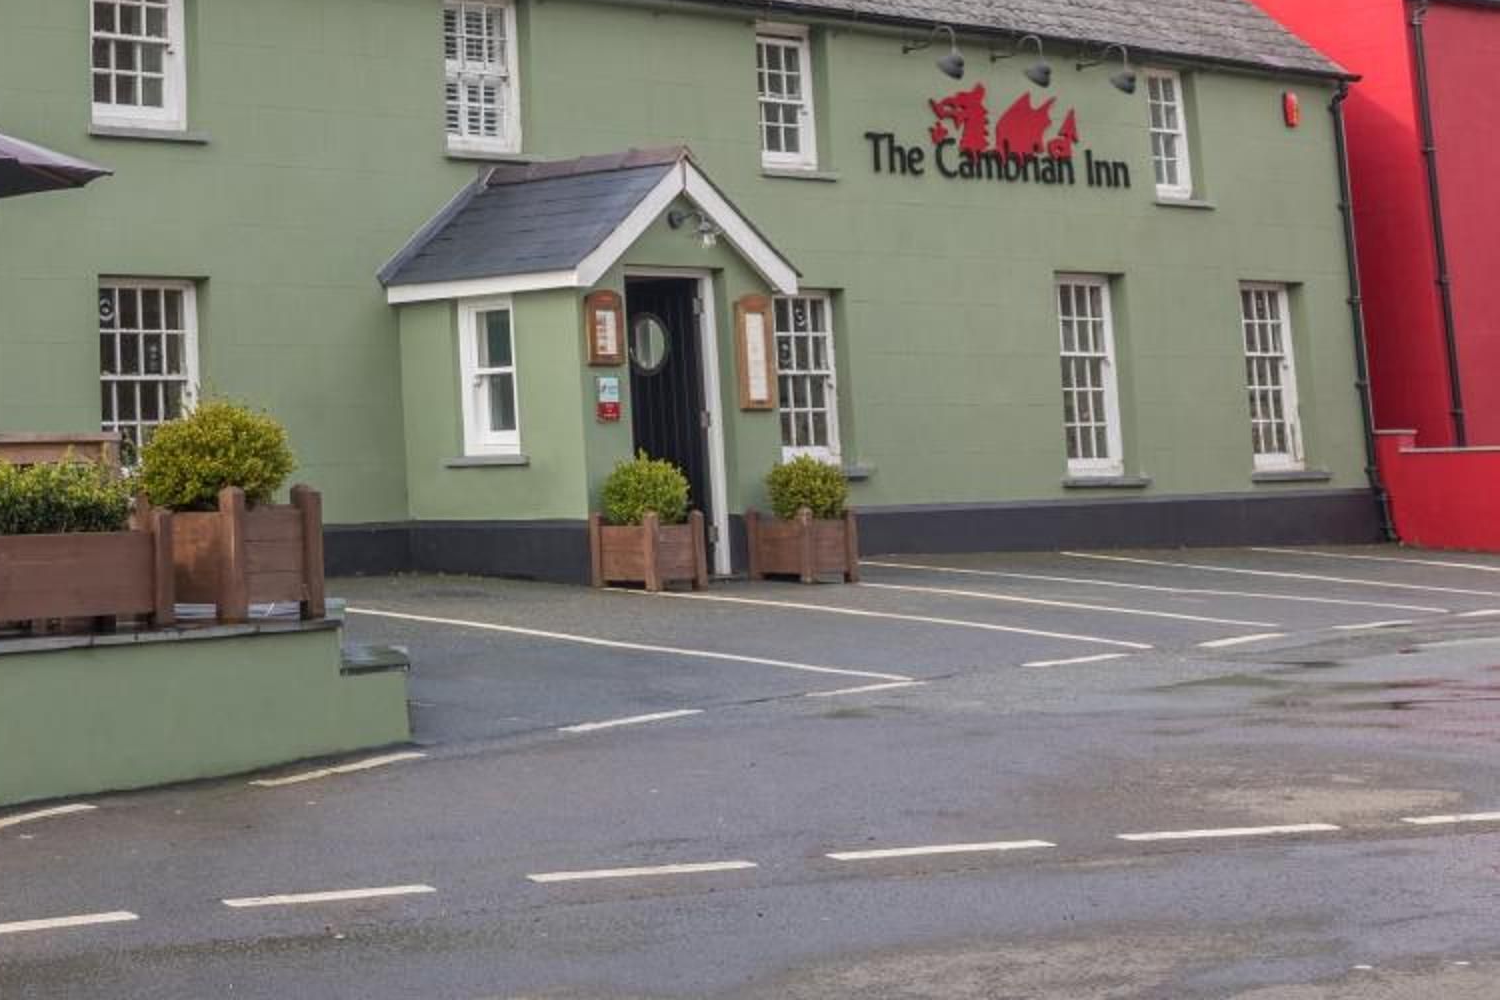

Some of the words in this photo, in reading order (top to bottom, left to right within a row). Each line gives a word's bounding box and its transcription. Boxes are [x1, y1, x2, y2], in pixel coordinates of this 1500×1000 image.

[865, 132, 924, 175] The
[935, 137, 1075, 184] Cambrian
[1085, 150, 1131, 188] Inn
